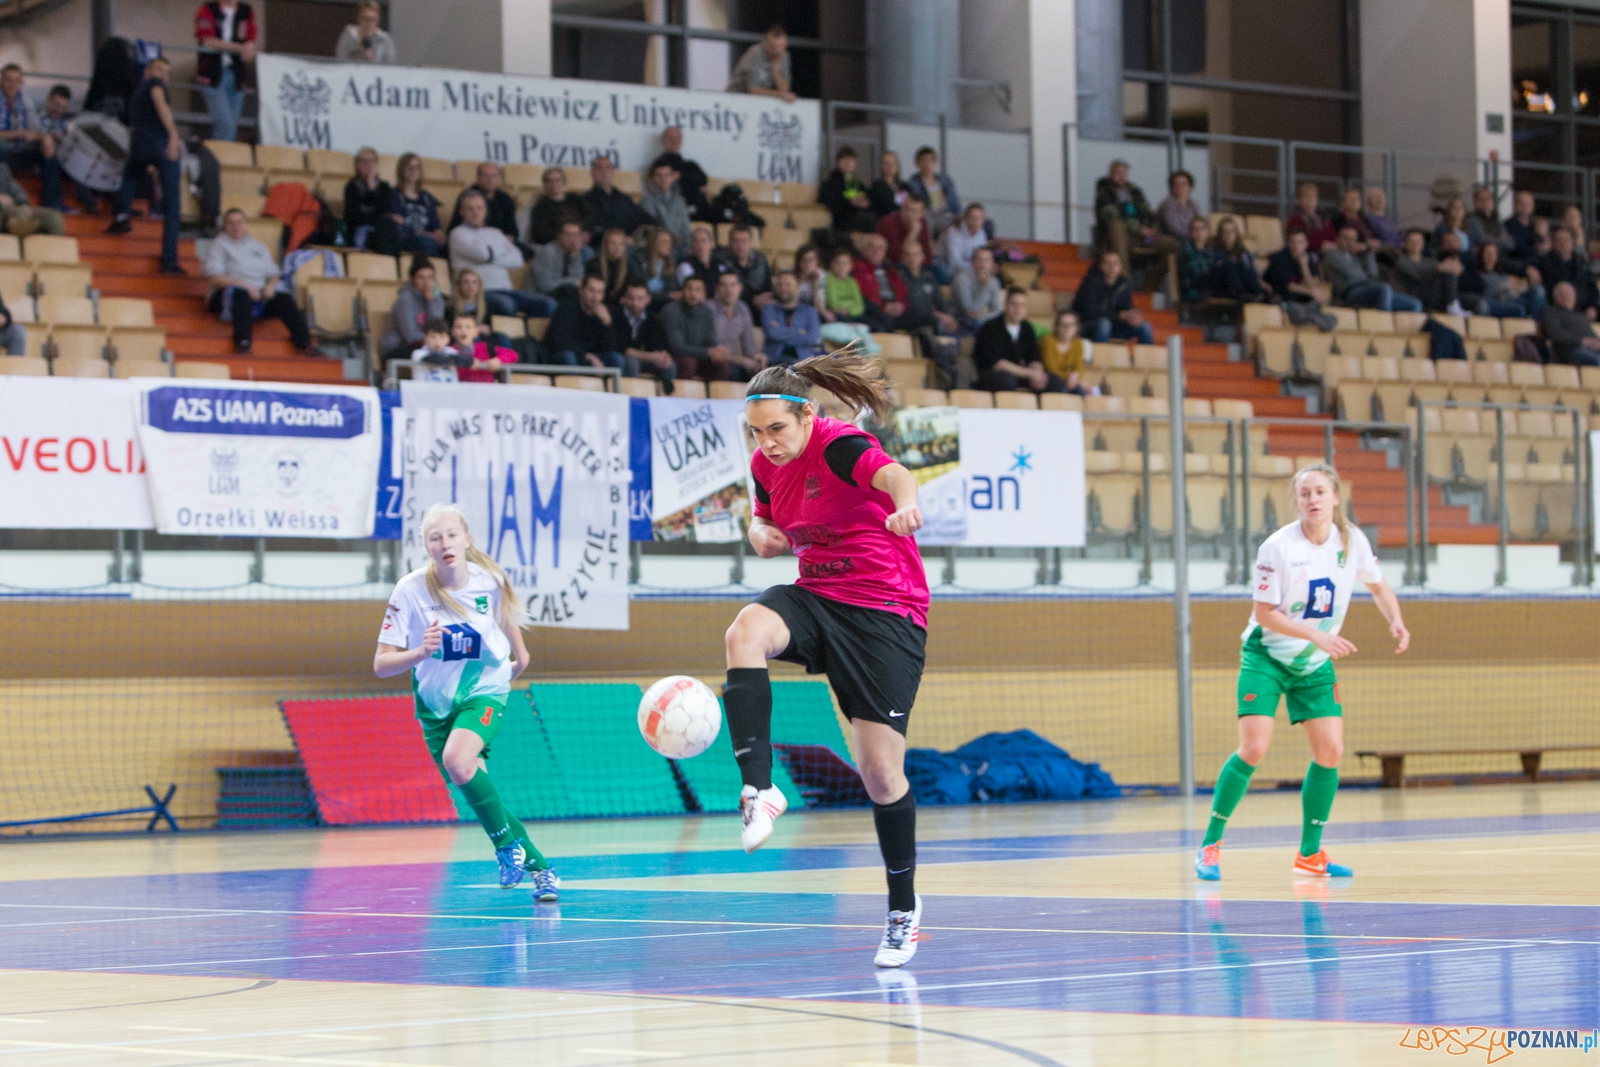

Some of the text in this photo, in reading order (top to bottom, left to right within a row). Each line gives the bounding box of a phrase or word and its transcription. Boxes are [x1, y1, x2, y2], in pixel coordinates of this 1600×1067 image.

[339, 76, 747, 142] Adam Mickiewicz University
[482, 131, 621, 169] in Poznań
[172, 397, 344, 428] AZS UAM Poznań
[422, 438, 450, 474] DLA
[492, 413, 515, 434] TO
[560, 427, 603, 477] LITER
[661, 421, 726, 472] UAM
[962, 474, 1020, 511] an
[177, 507, 340, 530] Orzełki Weissa
